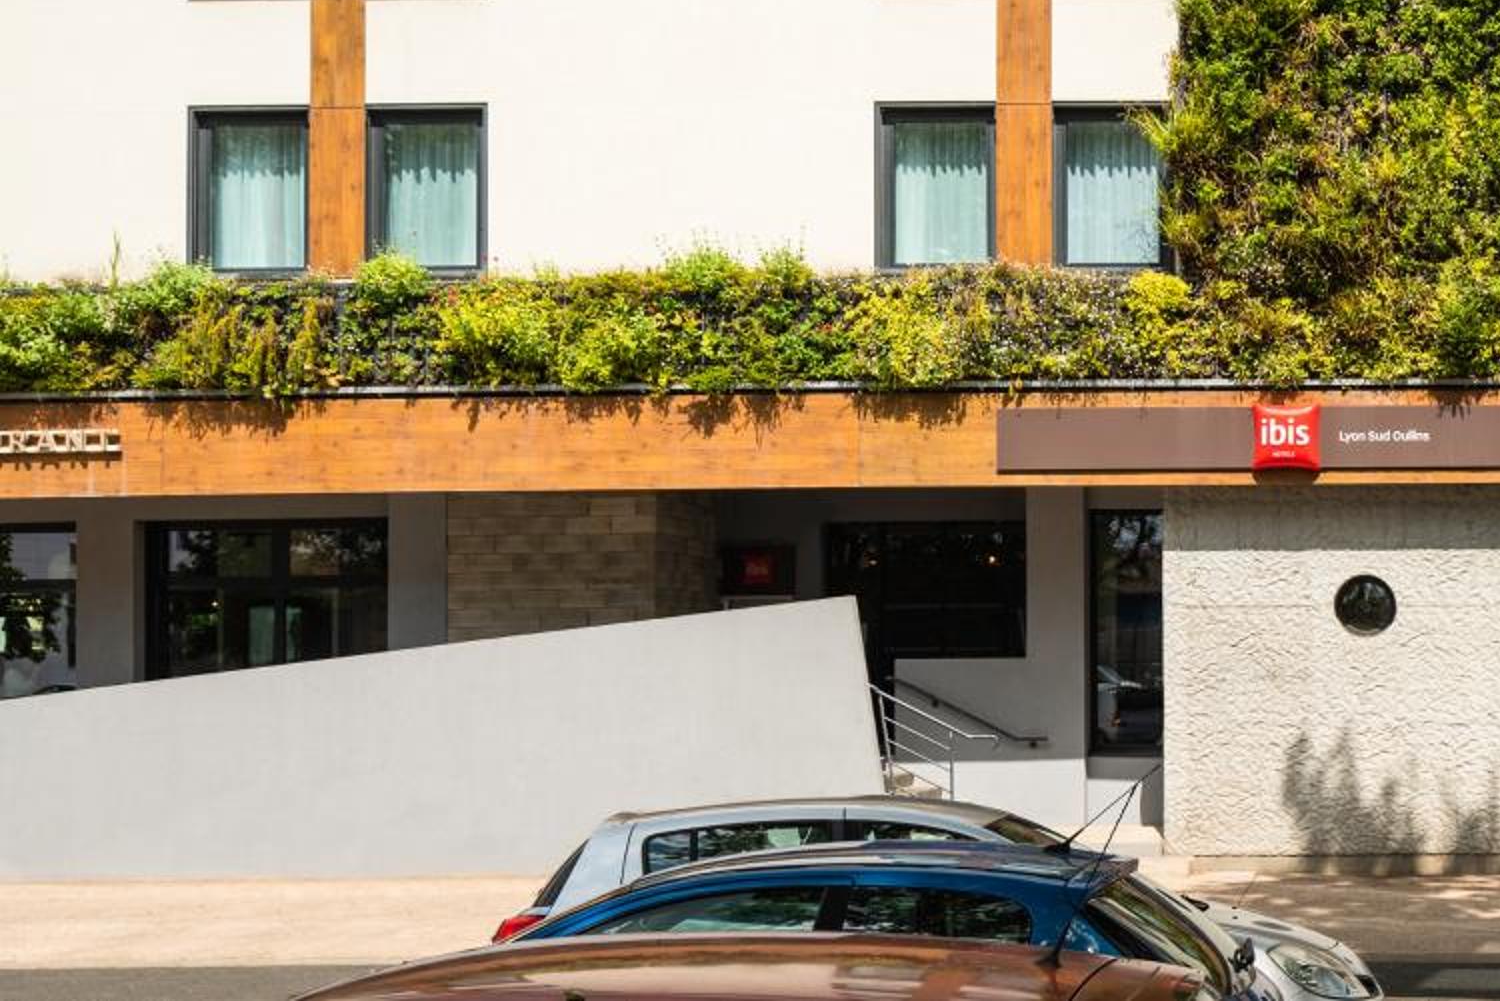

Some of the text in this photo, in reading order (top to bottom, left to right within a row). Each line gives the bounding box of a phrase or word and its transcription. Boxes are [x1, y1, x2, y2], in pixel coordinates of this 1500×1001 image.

[1260, 417, 1310, 446] ibis
[1339, 430, 1366, 444] Lyon
[1367, 430, 1391, 442] Sud
